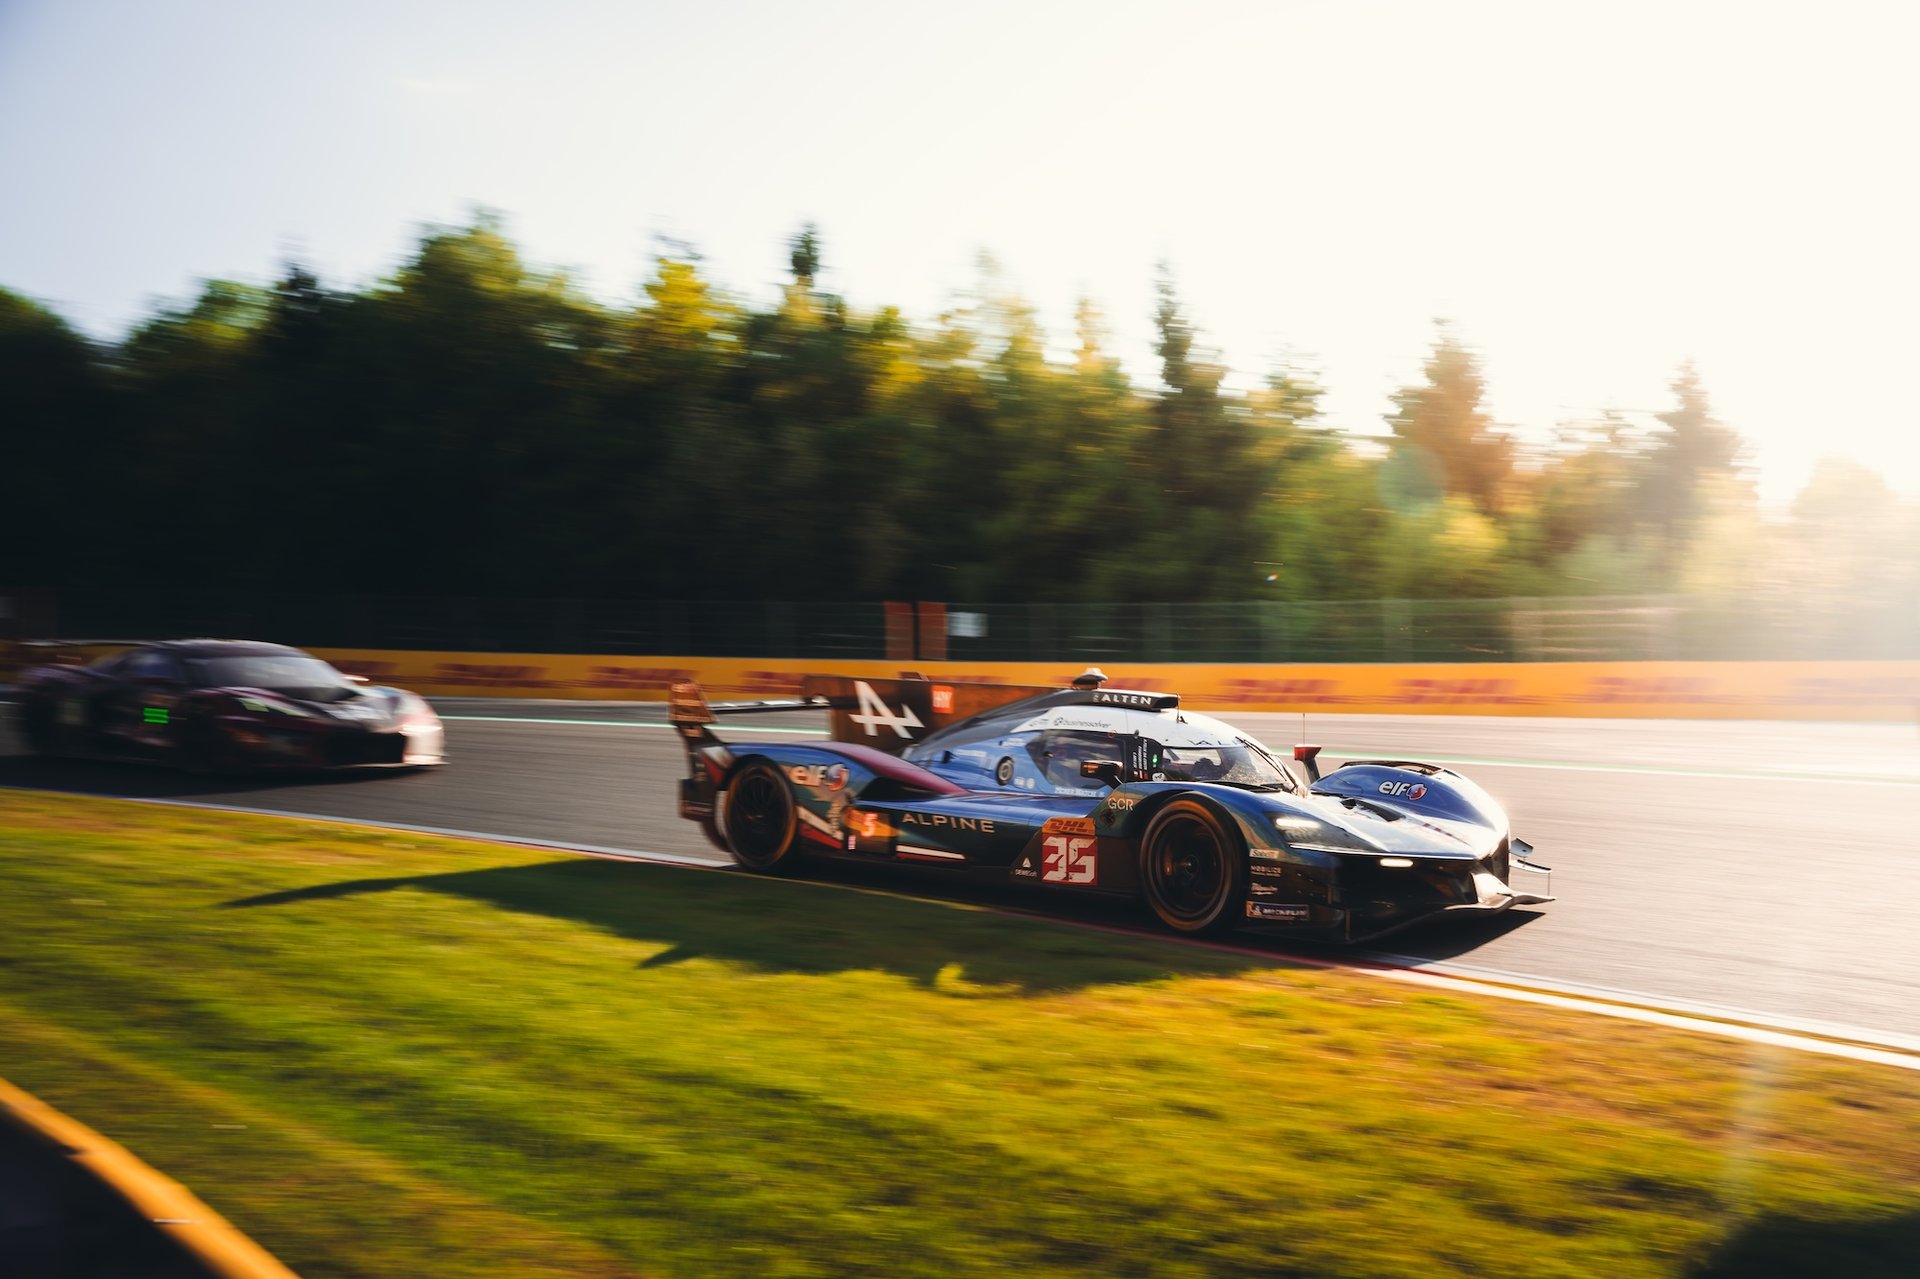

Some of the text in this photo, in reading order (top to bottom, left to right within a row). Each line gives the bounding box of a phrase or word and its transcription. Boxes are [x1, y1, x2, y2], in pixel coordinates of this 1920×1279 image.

[1101, 693, 1152, 705] ALTEN
[791, 765, 829, 787] elf
[1378, 781, 1410, 796] elf
[1108, 797, 1134, 811] GCR
[903, 813, 995, 833] ALPINE
[1050, 819, 1087, 832] DHL
[1043, 836, 1097, 883] 35
